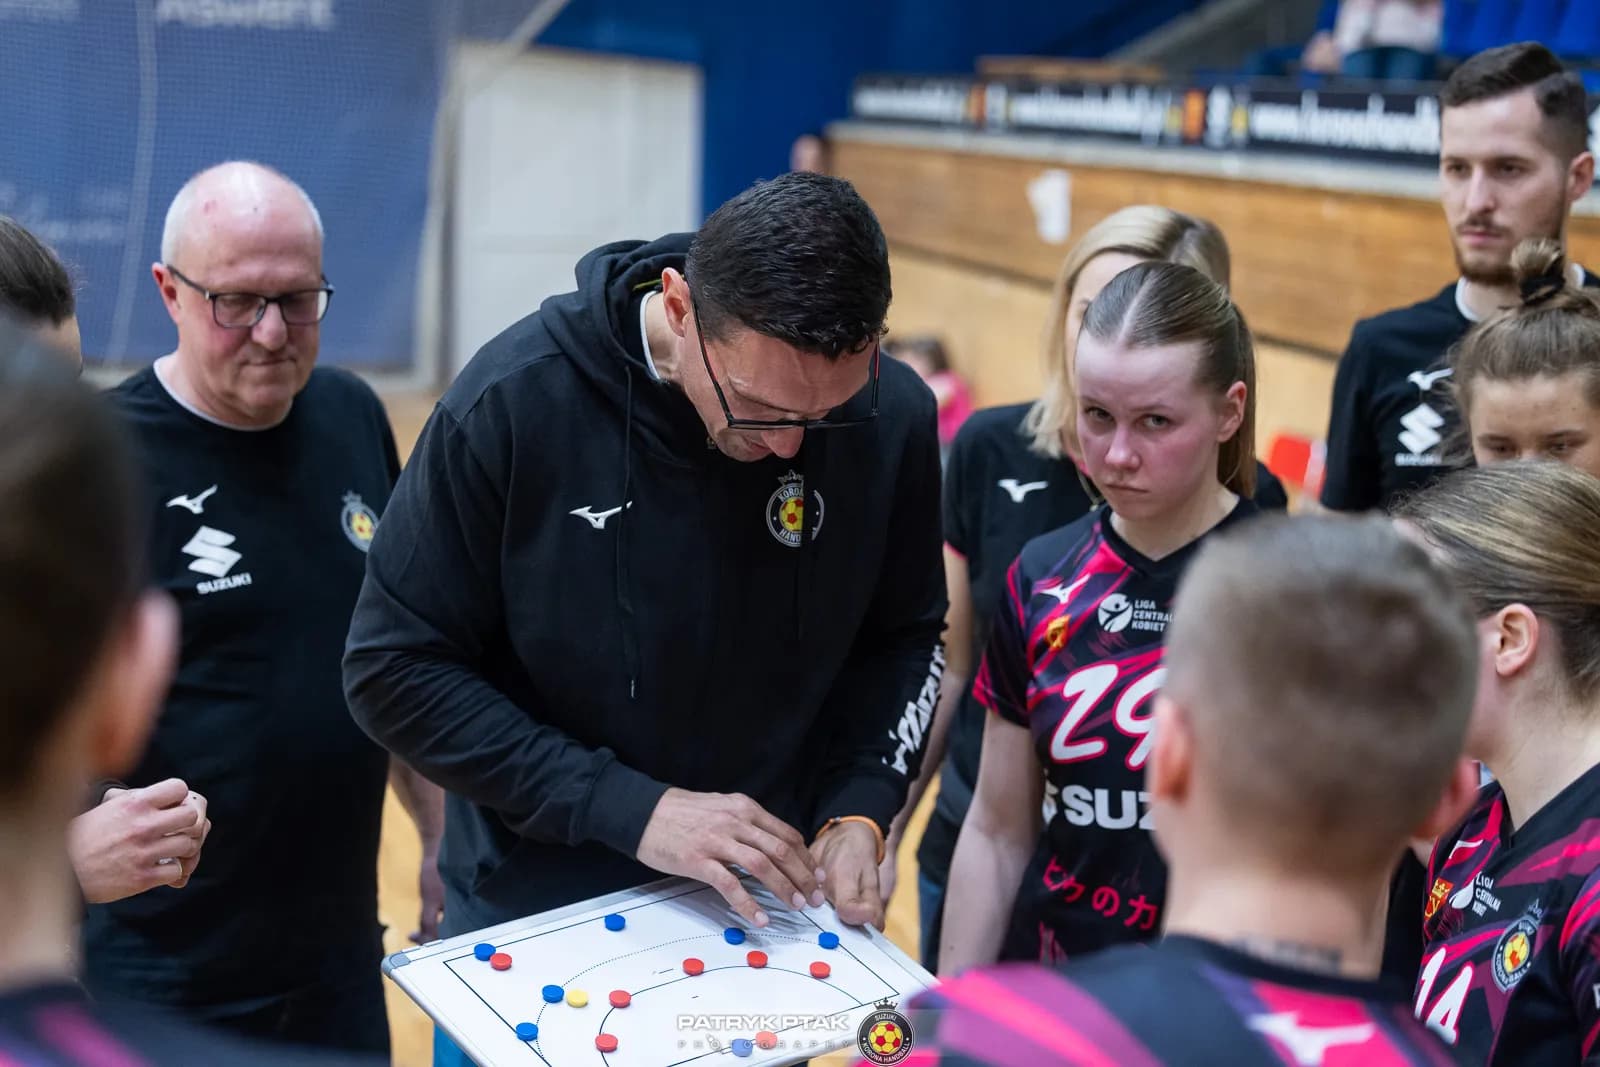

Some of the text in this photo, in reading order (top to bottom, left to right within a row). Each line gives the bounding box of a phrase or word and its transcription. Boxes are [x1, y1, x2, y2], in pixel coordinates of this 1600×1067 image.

[196, 572, 253, 595] SUZUKI
[1134, 599, 1156, 610] LIGA
[1131, 620, 1166, 632] KOBIET
[1050, 663, 1168, 769] 29
[1414, 946, 1474, 1045] 14
